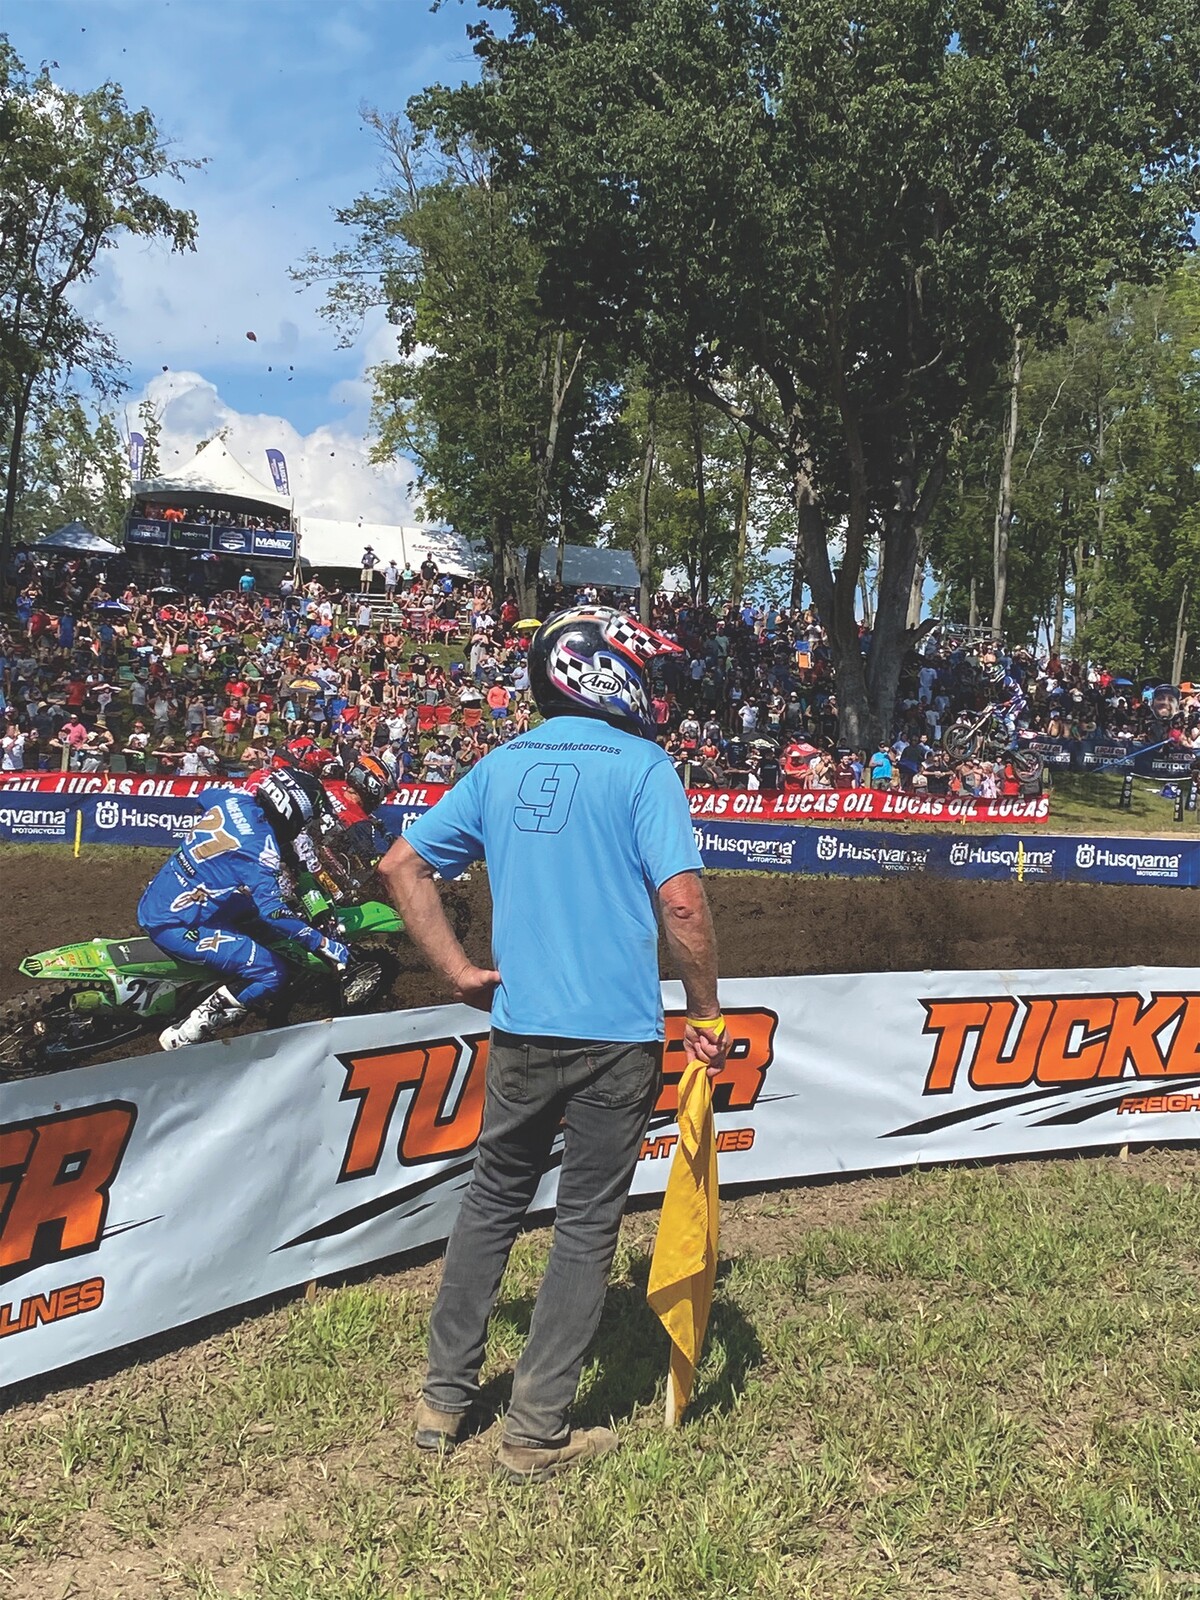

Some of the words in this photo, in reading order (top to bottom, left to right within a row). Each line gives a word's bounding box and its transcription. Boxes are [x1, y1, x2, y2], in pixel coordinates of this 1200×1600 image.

[581, 675, 617, 691] Arai
[506, 740, 622, 755] #50YearsofMotocross
[54, 778, 138, 796] LUCAS
[138, 781, 175, 797] OIL
[393, 789, 429, 806] OIL
[513, 762, 581, 834] 9
[689, 793, 729, 814] CAS
[732, 794, 764, 814] OIL
[773, 793, 840, 814] LUCAS
[843, 793, 874, 813] OIL
[882, 793, 945, 815] LUCAS
[949, 797, 978, 816] OIL
[987, 798, 1049, 817] LUCAS
[121, 808, 202, 832] Husqvar
[706, 833, 793, 856] Husqvarna
[1096, 849, 1179, 869] Husqvarna
[0, 1277, 105, 1338] LINES
